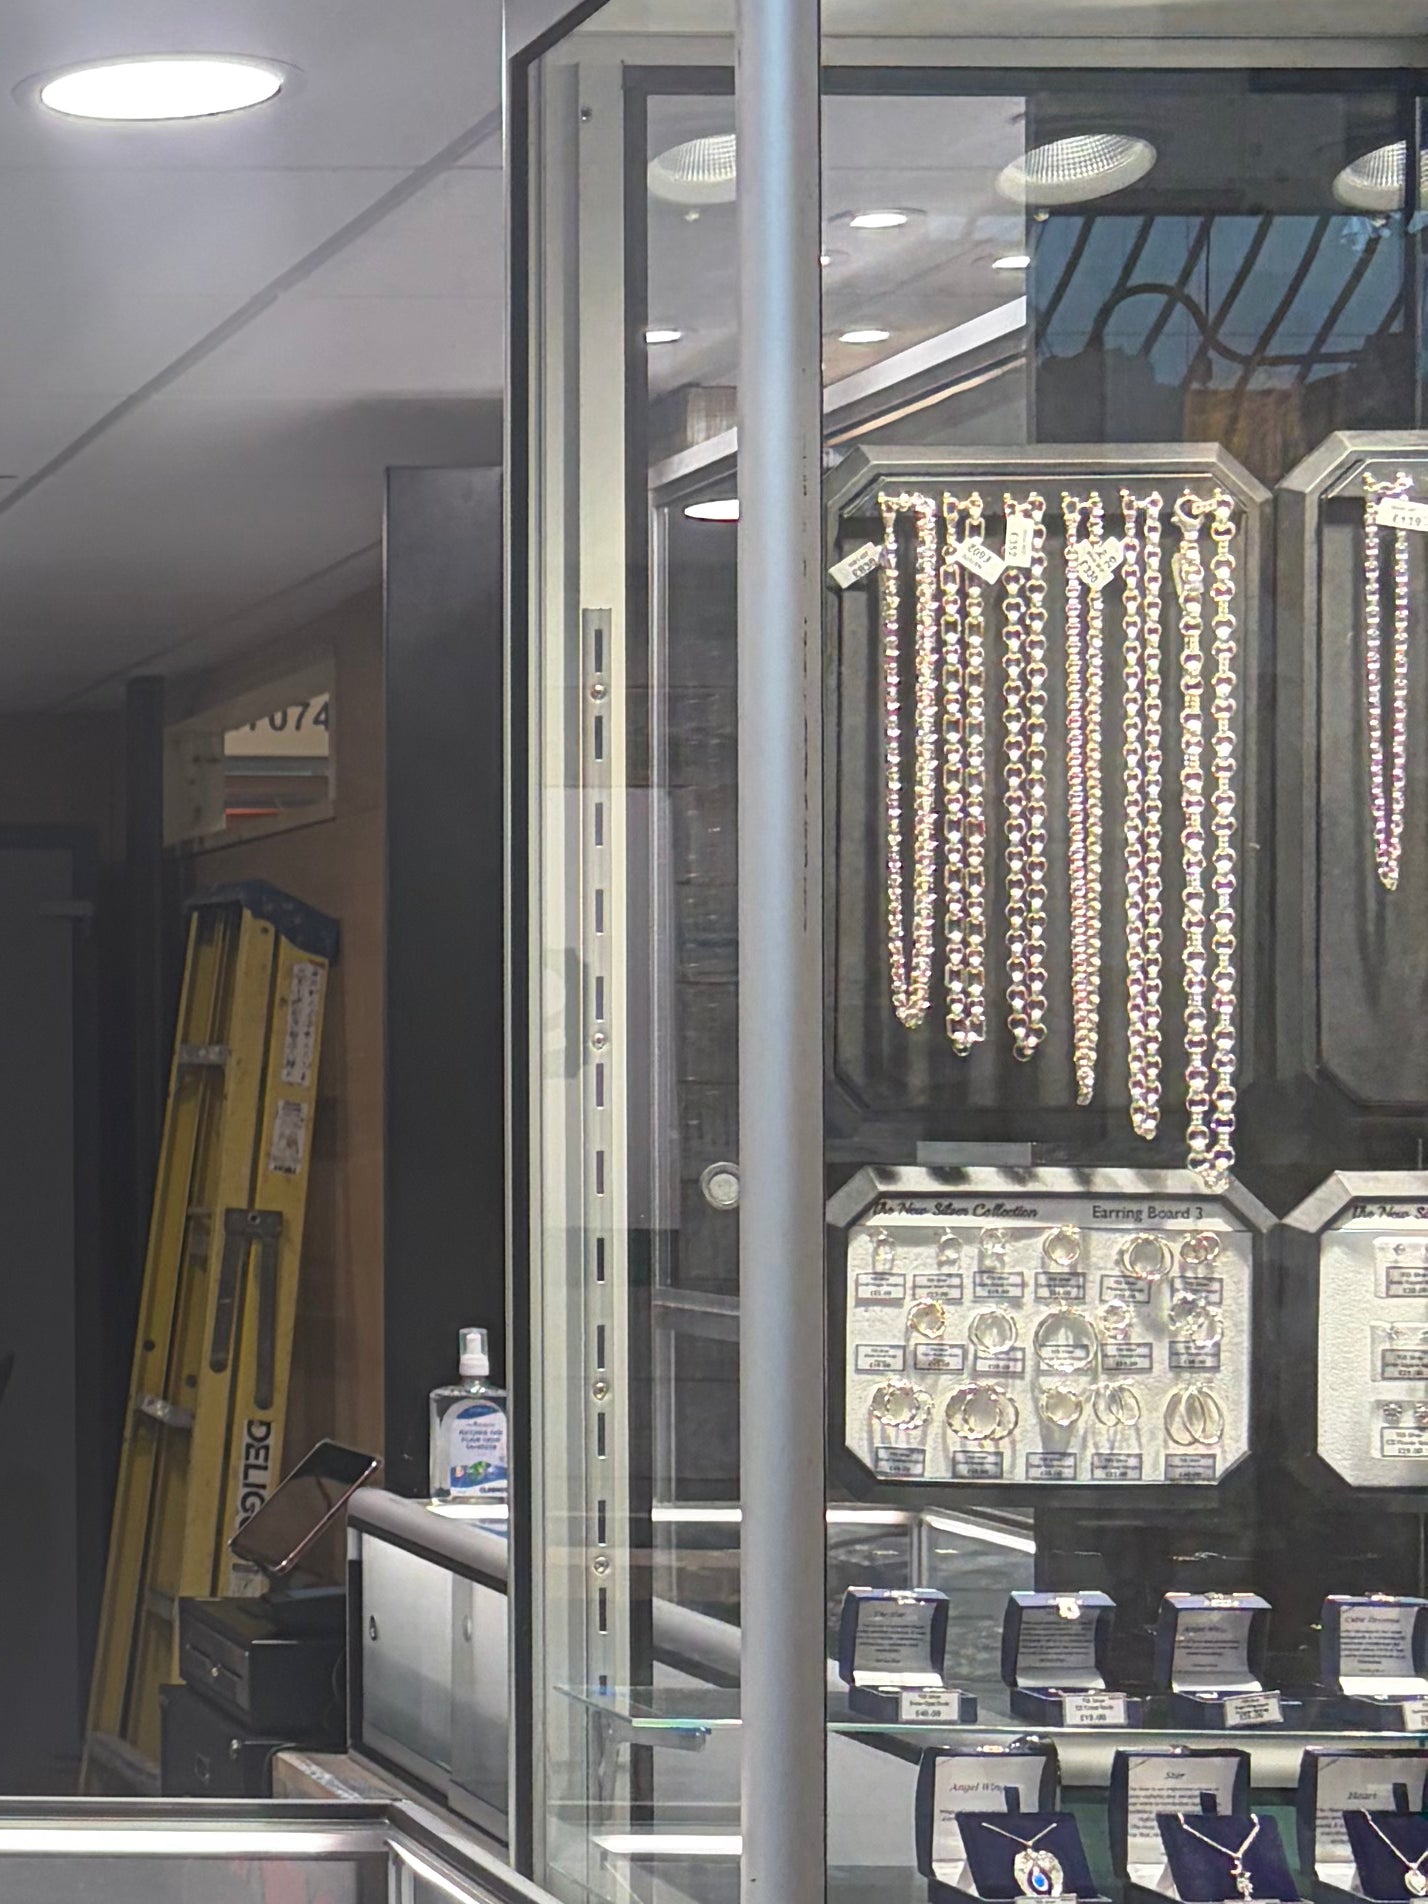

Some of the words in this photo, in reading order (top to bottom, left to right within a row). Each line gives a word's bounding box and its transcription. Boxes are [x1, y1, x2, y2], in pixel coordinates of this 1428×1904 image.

[249, 701, 328, 731] 074
[973, 1203, 1038, 1218] Collection
[1092, 1206, 1142, 1221] Earring
[1148, 1206, 1190, 1219] Board
[1195, 1207, 1203, 1219] 3
[949, 1782, 979, 1793] Angel
[982, 1782, 1008, 1793] Wing
